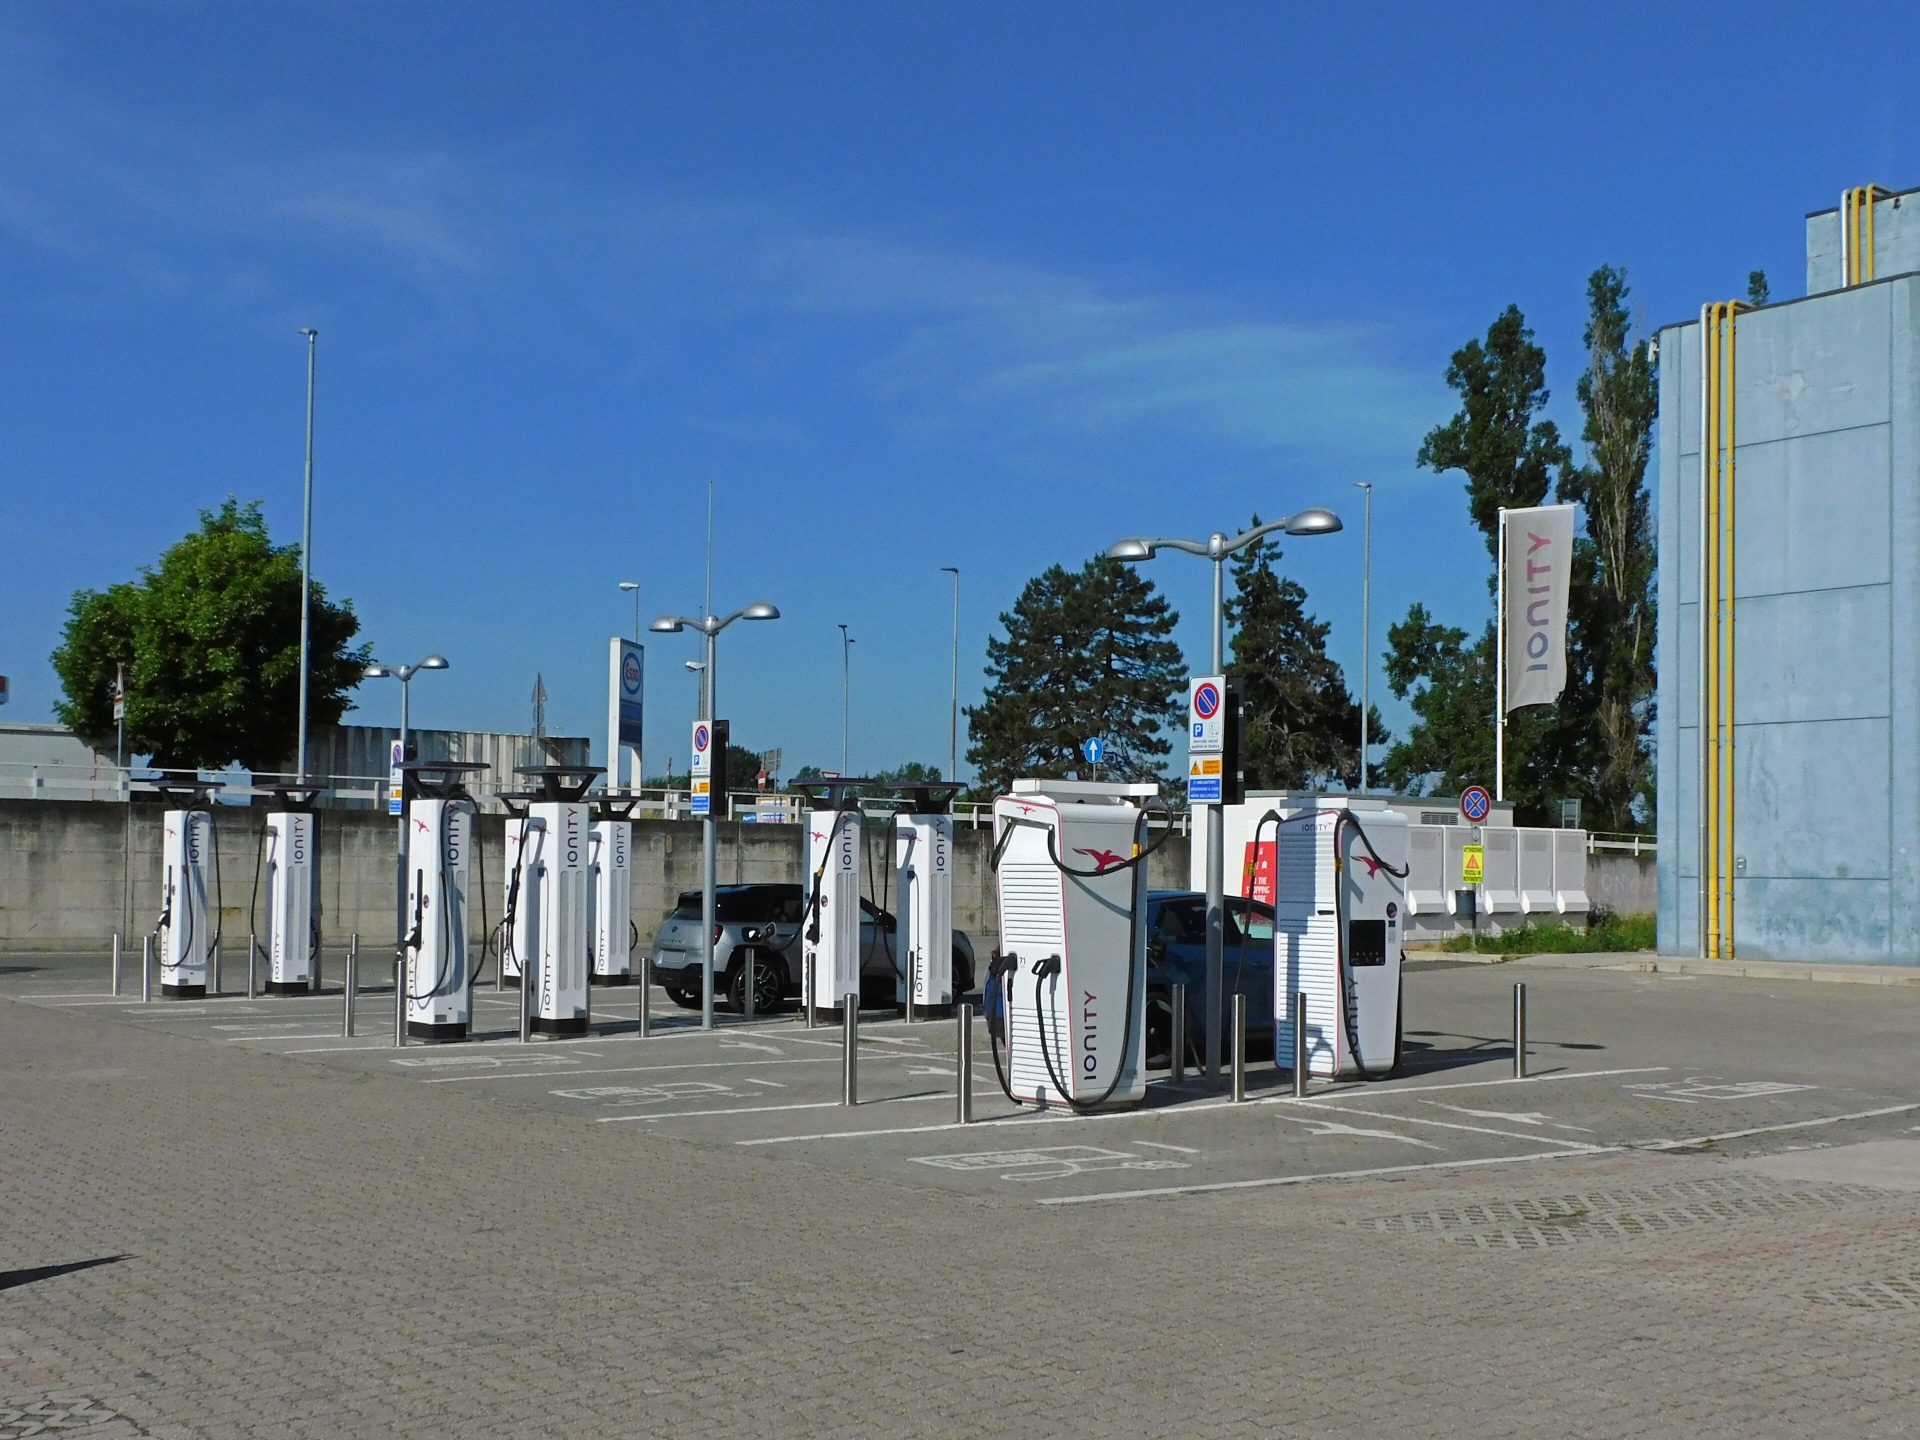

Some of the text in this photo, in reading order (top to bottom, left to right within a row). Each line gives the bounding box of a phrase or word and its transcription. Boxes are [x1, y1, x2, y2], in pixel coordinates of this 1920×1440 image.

[1526, 531, 1552, 673] IONITY
[190, 814, 200, 864] IONITY
[294, 816, 304, 864] IONITY
[448, 803, 460, 866] IONITY
[568, 807, 578, 868] IONITY
[616, 824, 625, 868] IONITY
[843, 815, 852, 871] IONITY
[937, 818, 945, 872] IONITY
[544, 952, 552, 1011] IONITY
[1083, 990, 1098, 1081] IONITY
